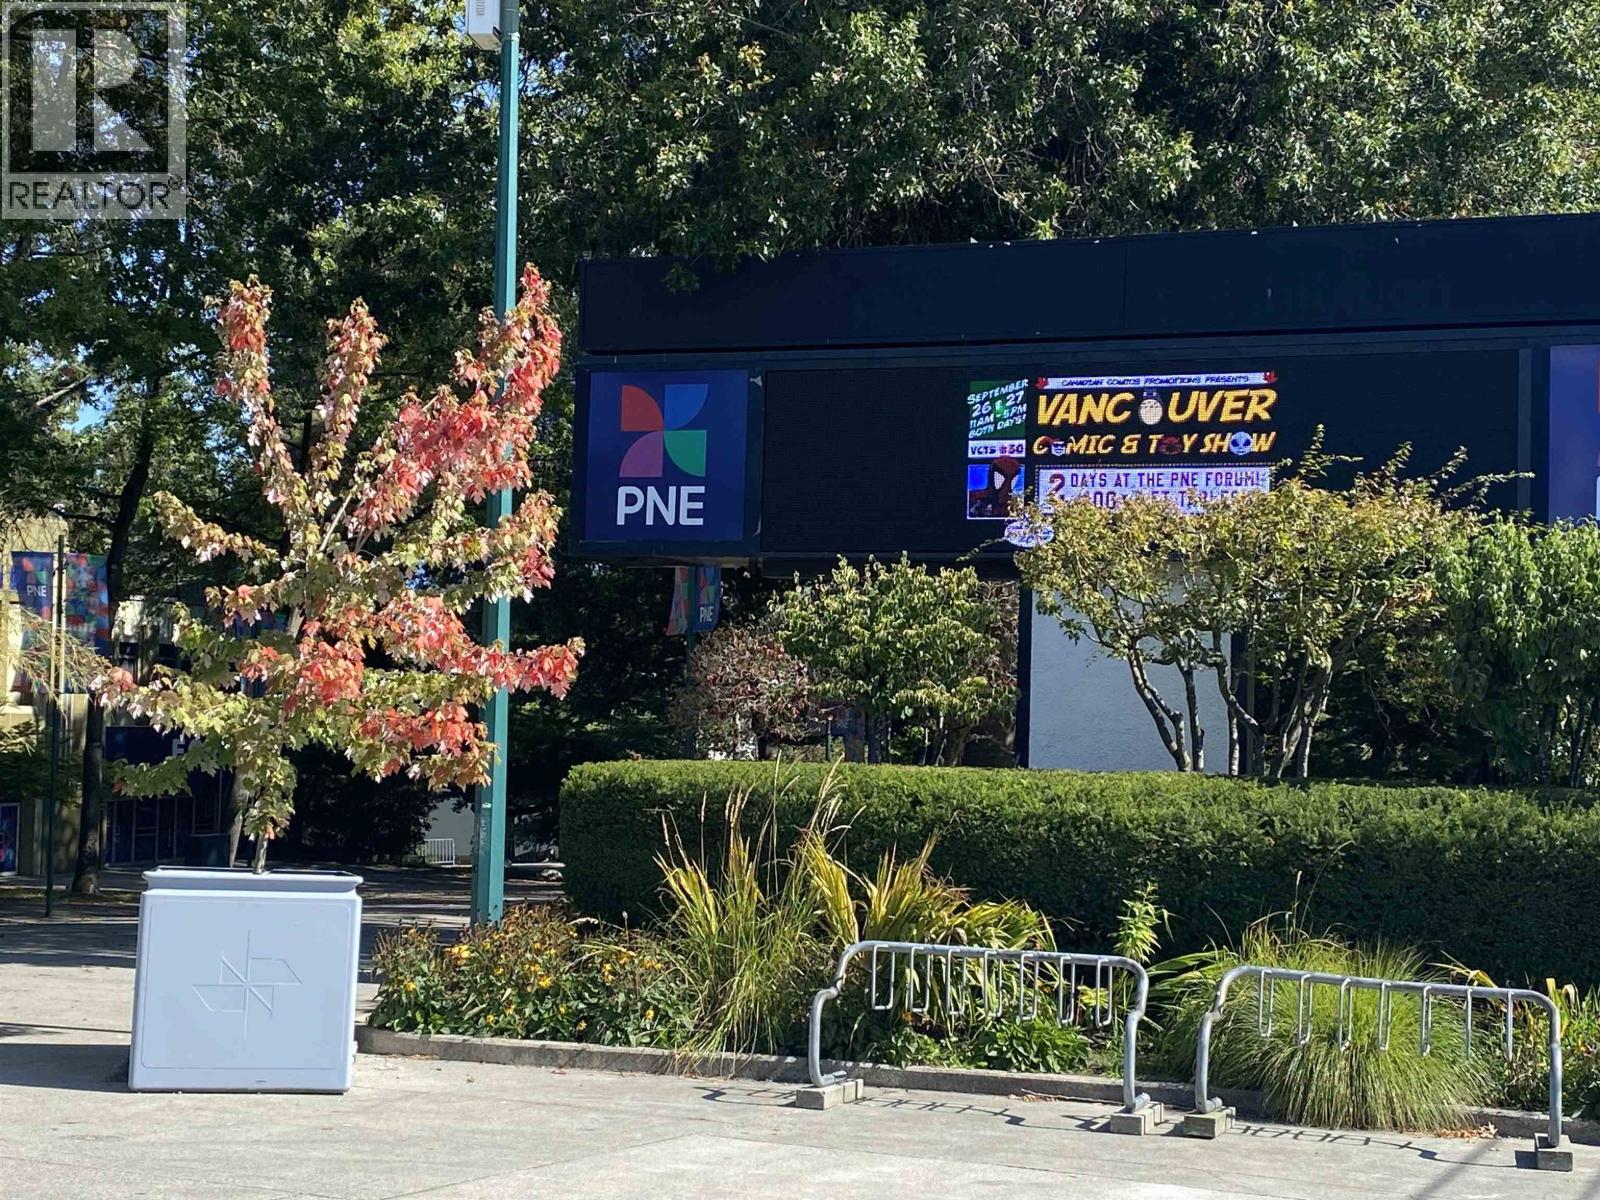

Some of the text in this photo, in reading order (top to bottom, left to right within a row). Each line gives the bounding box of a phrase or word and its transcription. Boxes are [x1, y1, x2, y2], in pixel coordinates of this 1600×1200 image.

[967, 378, 1029, 404] SEPTEMBER
[972, 401, 992, 417] 26
[1005, 390, 1024, 406] 27
[1037, 389, 1277, 425] VANCUVER
[968, 424, 995, 439] BOTH
[1033, 434, 1116, 456] CMIC
[1148, 433, 1198, 455] TY
[1200, 431, 1276, 455] SHW
[1071, 472, 1107, 488] DAYS
[1114, 472, 1130, 487] AT
[1137, 472, 1165, 487] THE
[1170, 472, 1199, 487] PNE
[616, 485, 705, 526] PNE
[26, 585, 47, 597] PNE
[700, 606, 714, 623] PNE
